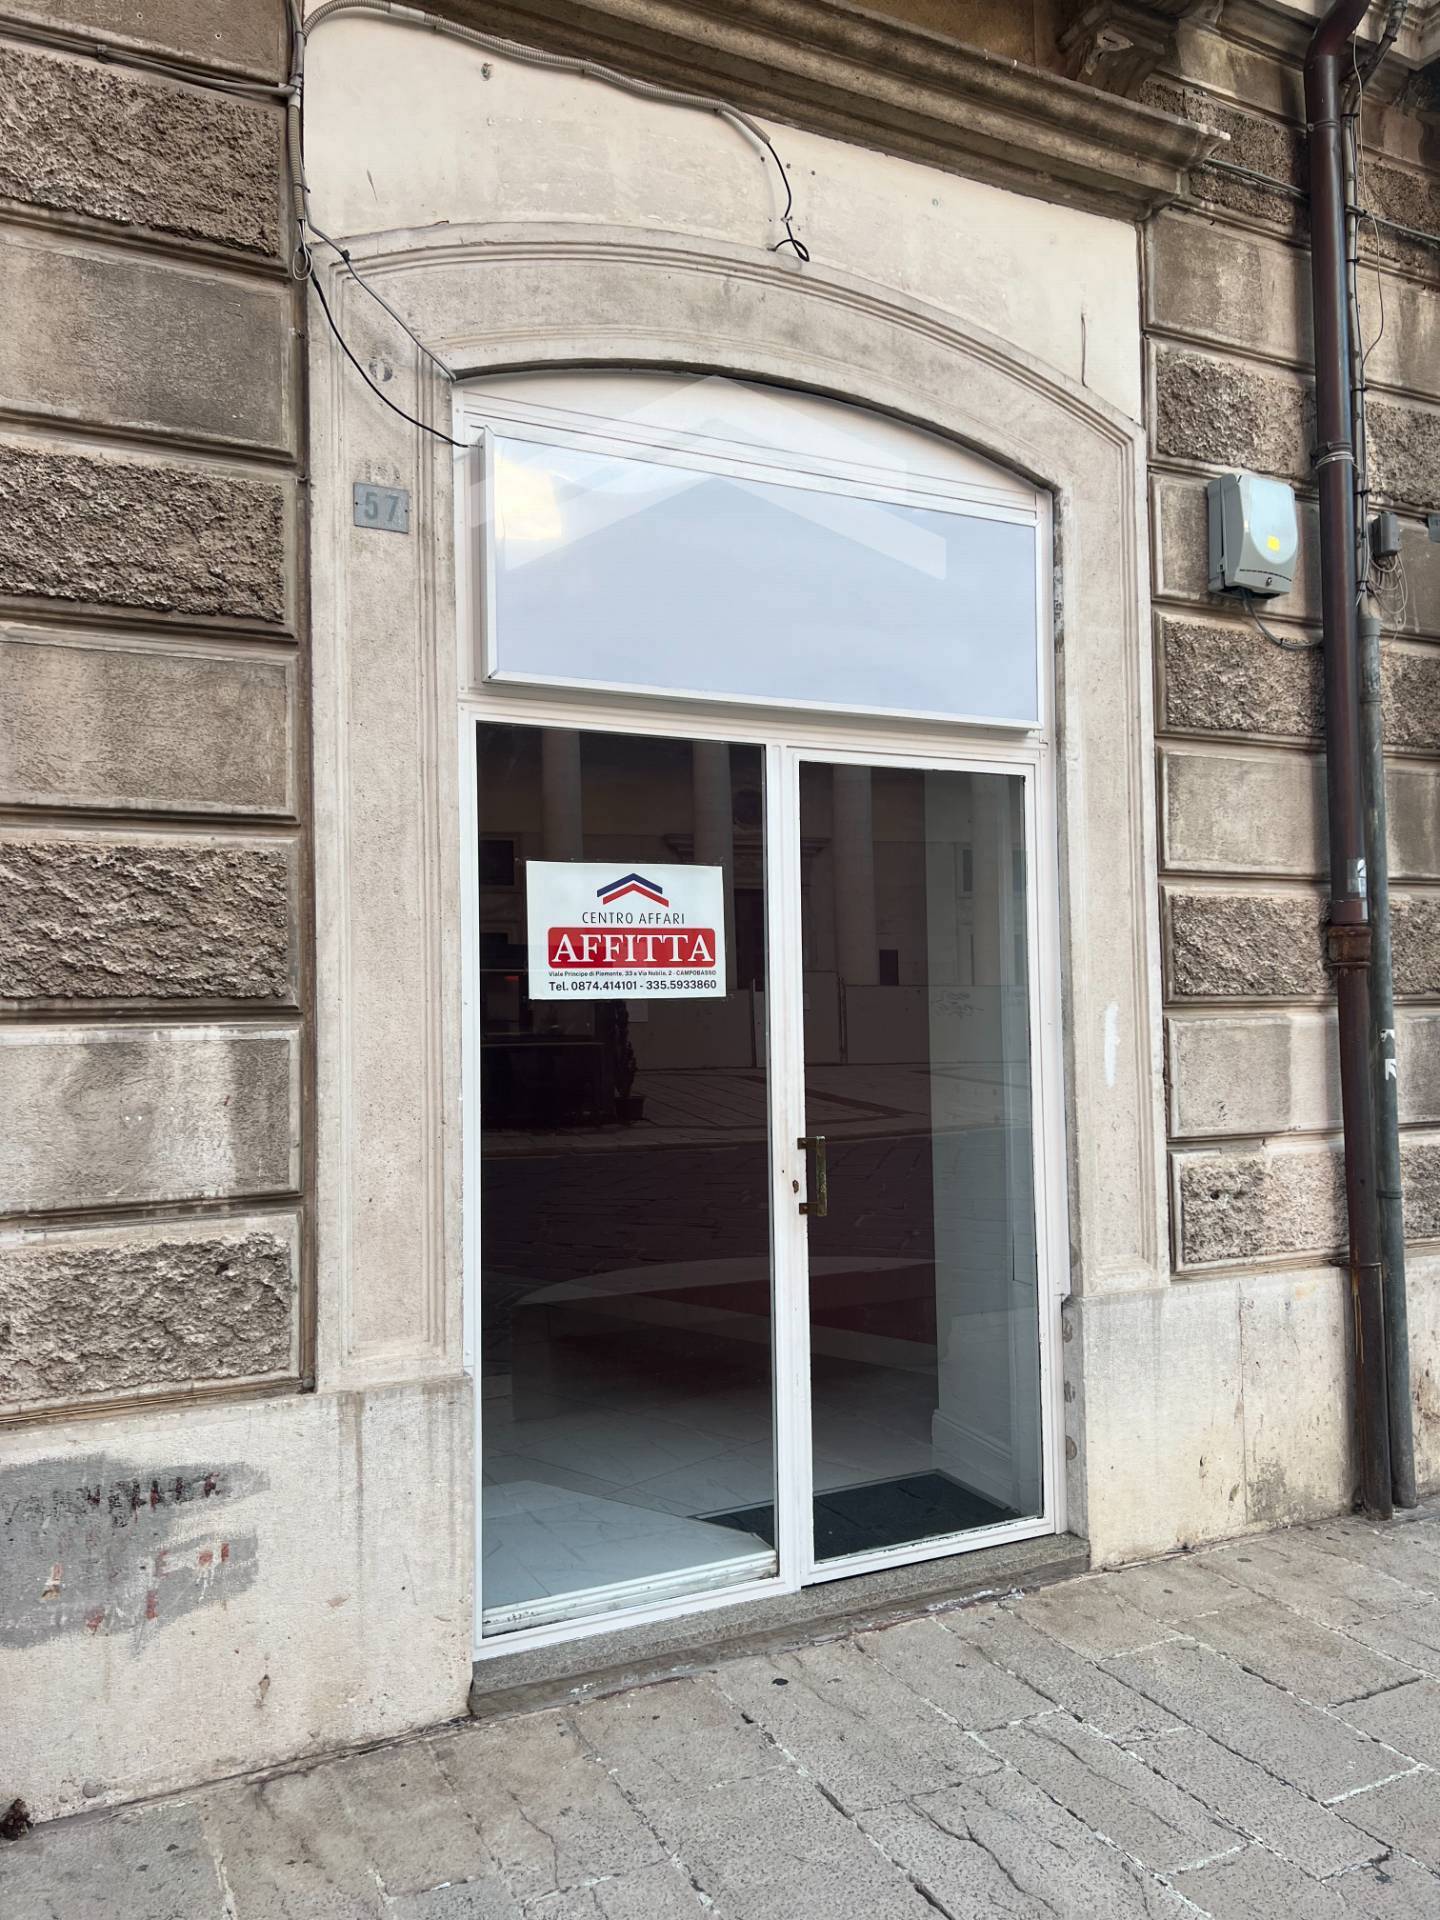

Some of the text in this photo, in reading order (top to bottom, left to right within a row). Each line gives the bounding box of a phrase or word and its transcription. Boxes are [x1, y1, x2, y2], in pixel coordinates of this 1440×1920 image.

[364, 492, 399, 522] 57
[582, 911, 685, 925] CENTRO AFFARI
[551, 934, 714, 963] AFFITTA
[564, 970, 588, 978] Principe
[548, 981, 569, 991] Tel.
[570, 980, 637, 991] 0874.414101
[646, 980, 717, 990] 335.5933860
